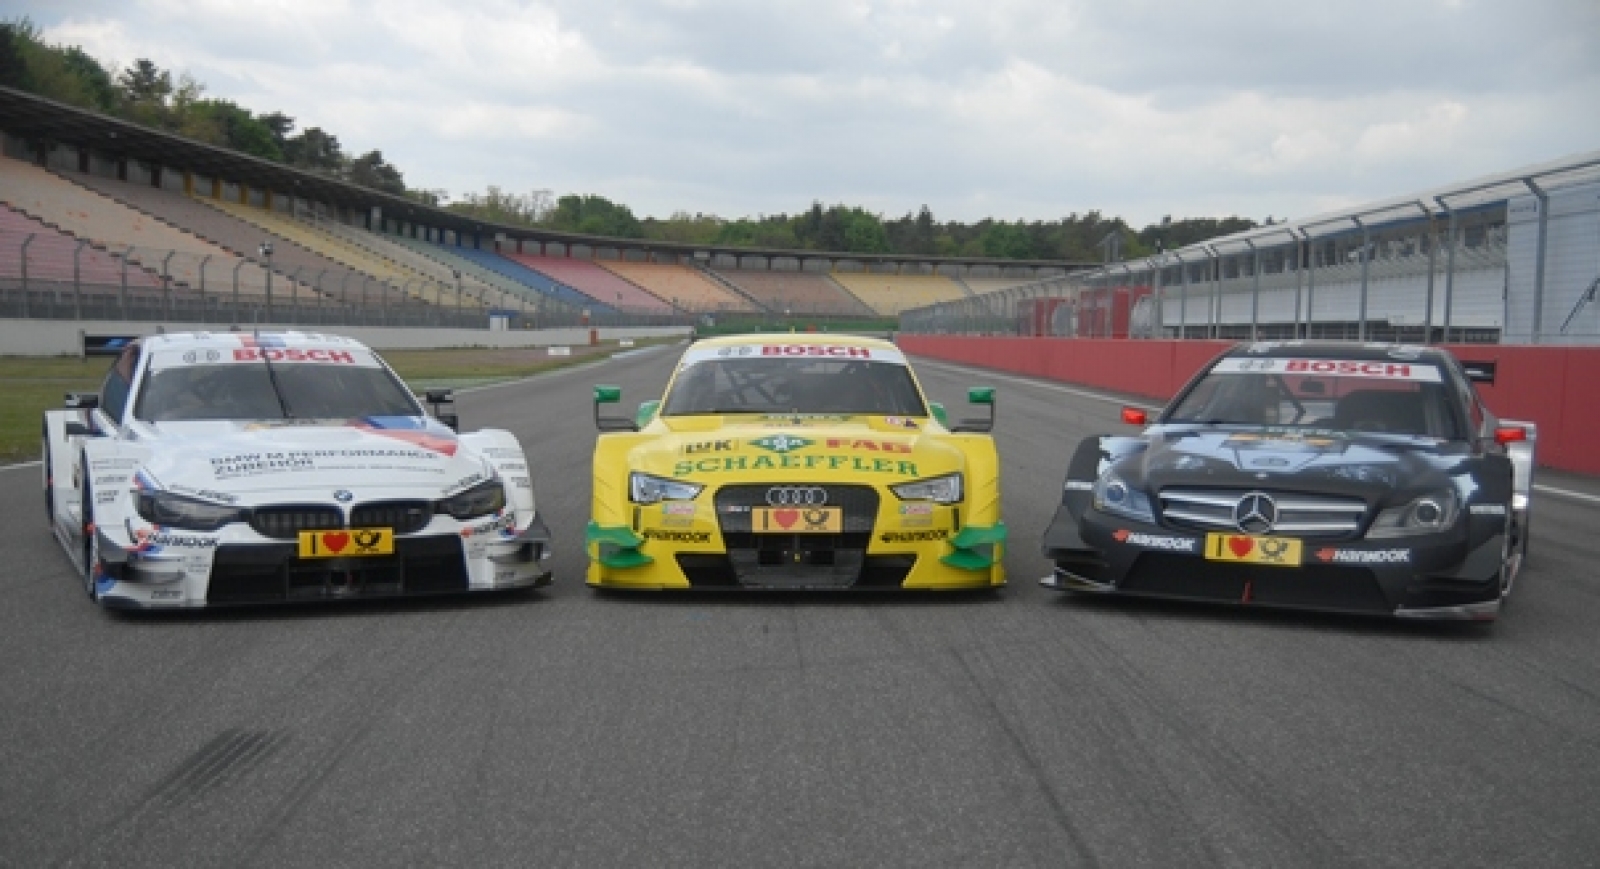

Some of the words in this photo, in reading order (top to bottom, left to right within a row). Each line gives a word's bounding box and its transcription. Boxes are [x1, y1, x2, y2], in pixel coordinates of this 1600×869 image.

[232, 348, 356, 364] BOSCH
[761, 345, 872, 358] BOSCH
[1284, 359, 1411, 377] BOSCH
[825, 438, 913, 454] FAG
[672, 454, 920, 478] SCHAEFFLER
